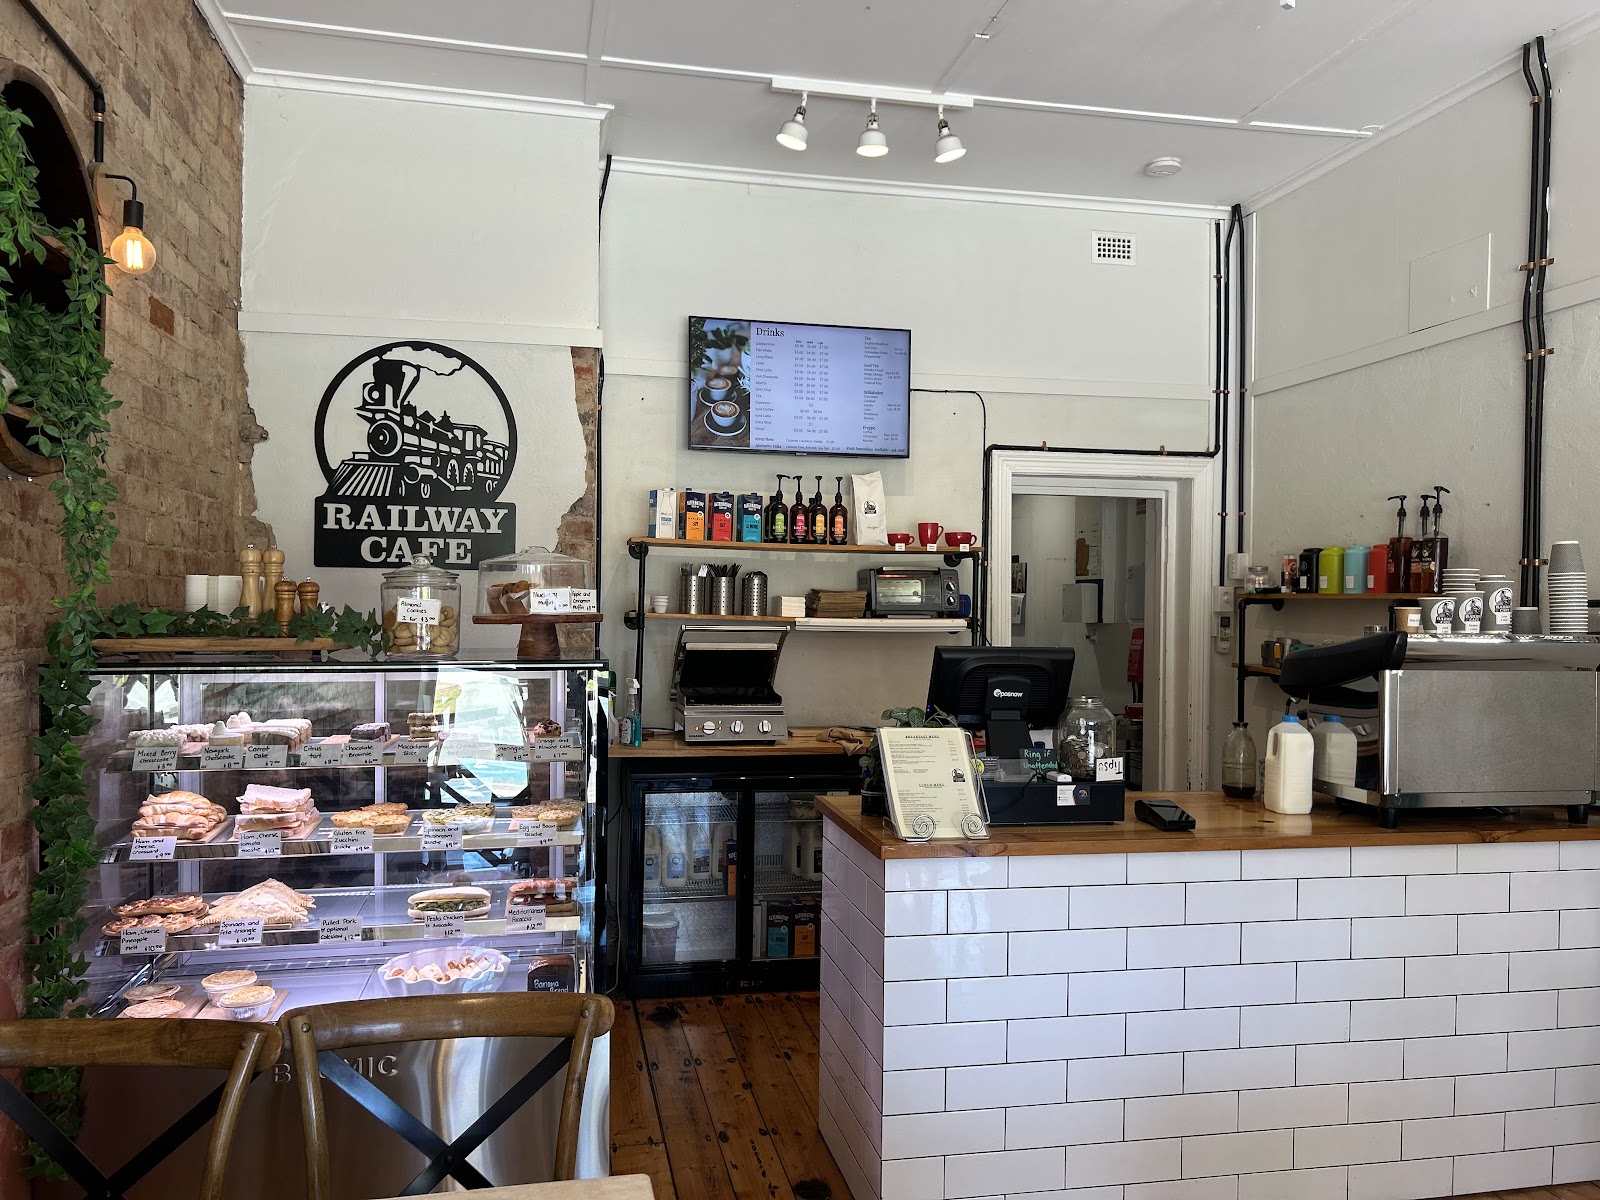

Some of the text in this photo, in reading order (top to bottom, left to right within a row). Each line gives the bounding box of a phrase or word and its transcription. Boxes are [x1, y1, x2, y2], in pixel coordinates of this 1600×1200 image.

[756, 327, 785, 337] Drinks
[323, 502, 508, 534] RAILWAY
[361, 536, 472, 564] CAFE
[161, 749, 176, 759] Berry
[1024, 749, 1051, 761] Ring if
[1023, 761, 1058, 770] Unattended
[519, 824, 529, 832] Egg
[233, 927, 256, 935] triangle
[533, 978, 559, 989] Banana
[275, 1055, 398, 1083] BMIC
